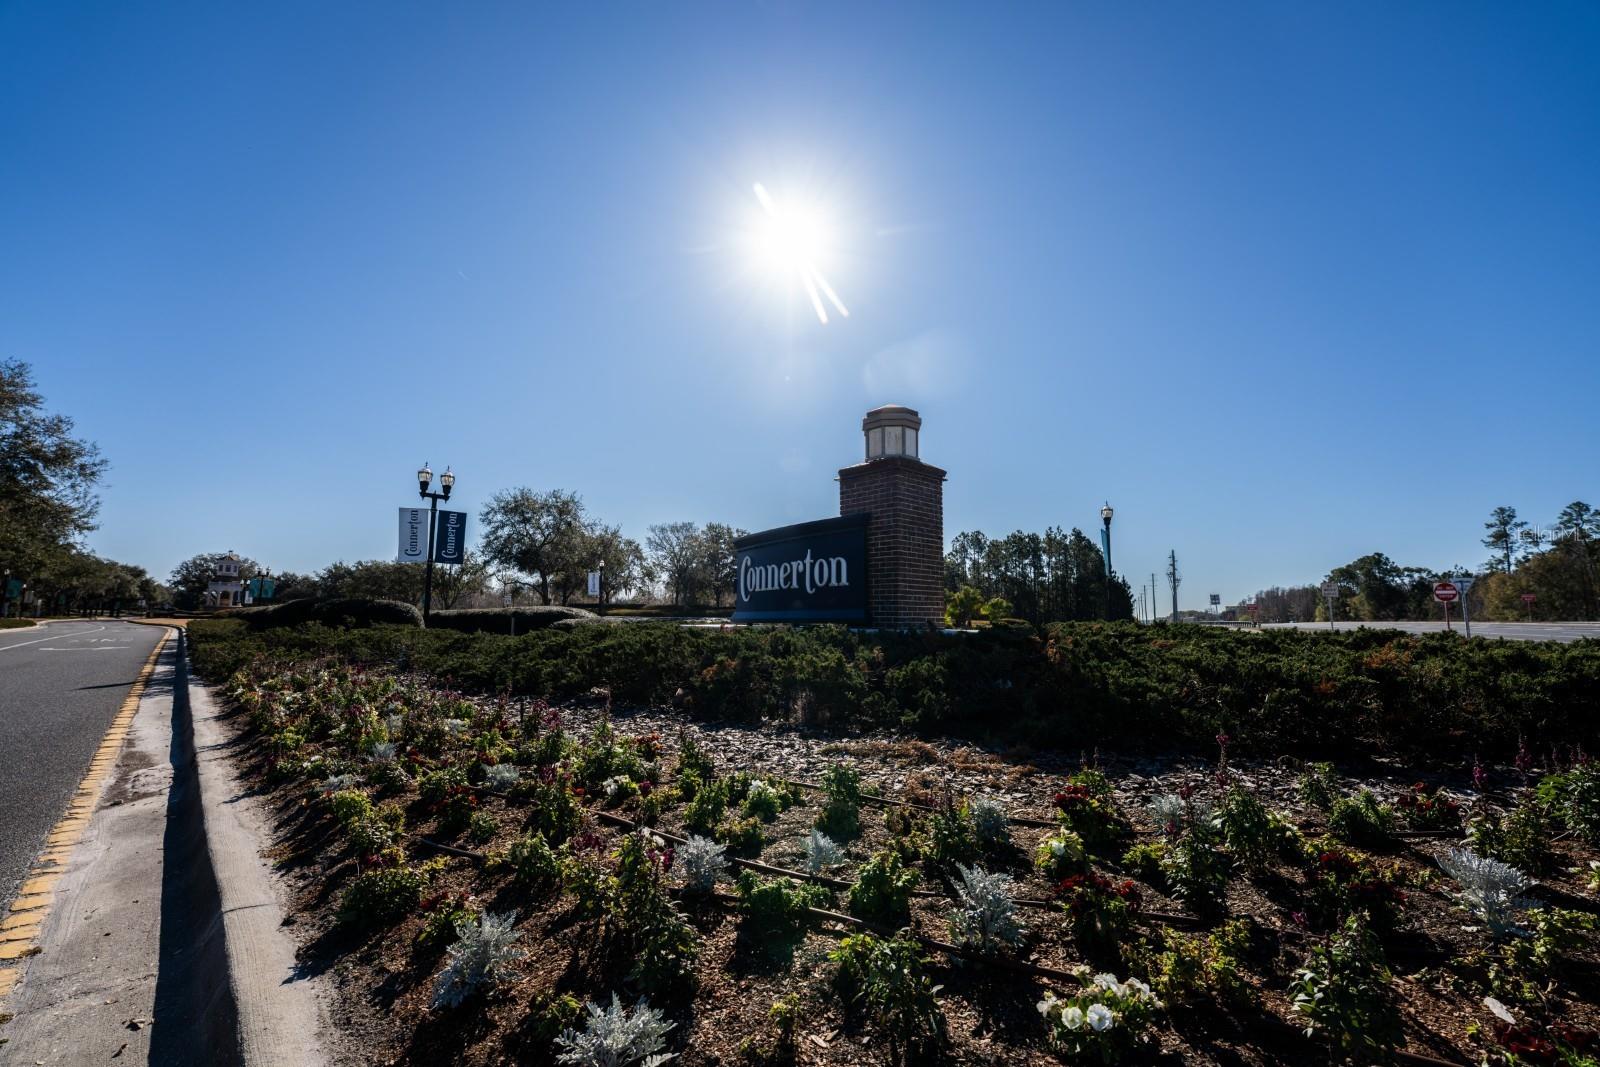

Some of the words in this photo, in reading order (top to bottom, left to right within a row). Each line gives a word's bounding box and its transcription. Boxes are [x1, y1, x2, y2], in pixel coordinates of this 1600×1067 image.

[405, 510, 422, 556] Connerton
[442, 513, 460, 558] Connerton
[740, 549, 849, 602] Connerton
